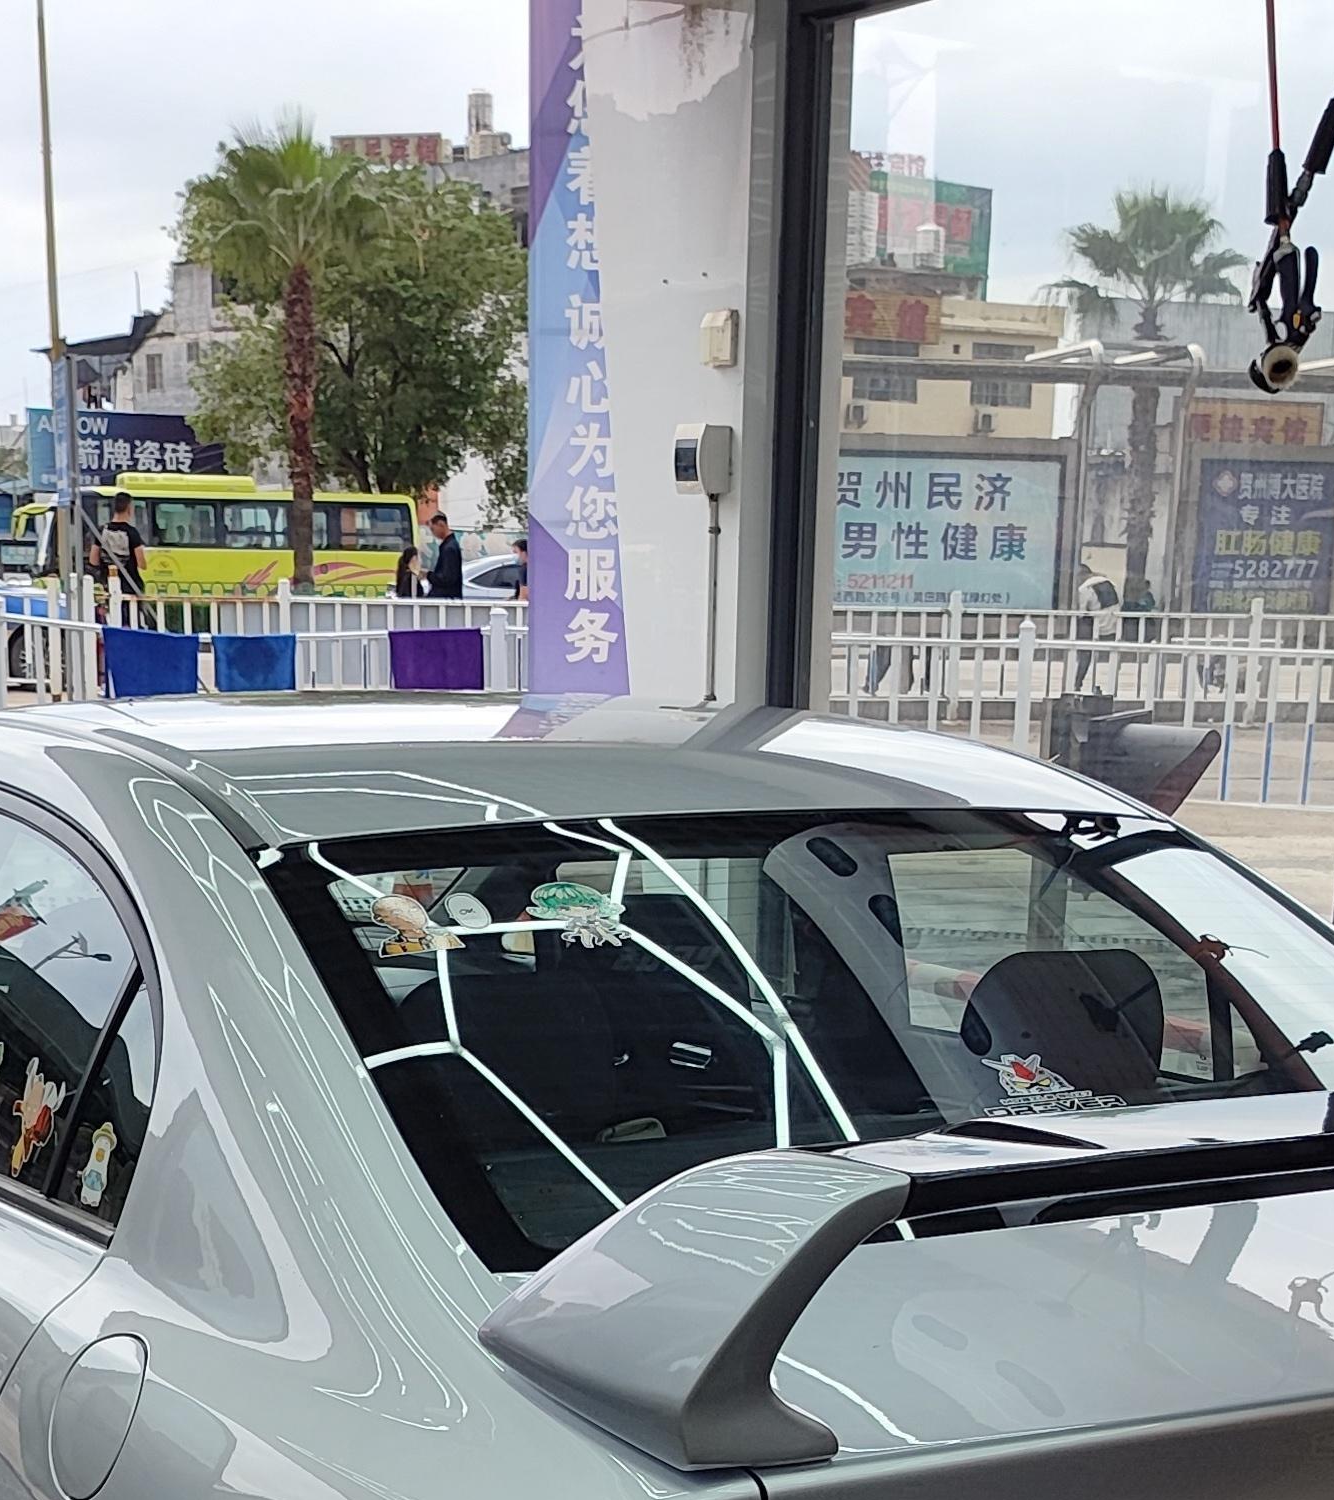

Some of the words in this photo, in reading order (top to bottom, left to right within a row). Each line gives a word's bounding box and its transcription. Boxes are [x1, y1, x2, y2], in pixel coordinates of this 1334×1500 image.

[78, 437, 194, 473] 箭牌瓷砖
[565, 294, 618, 663] 诚心为您服务
[837, 471, 1013, 512] 贺州民济
[841, 521, 1028, 562] 男性健康
[1214, 529, 1322, 556] 肛肠健康
[847, 573, 914, 589] 5211211
[1232, 559, 1319, 578] 5282777
